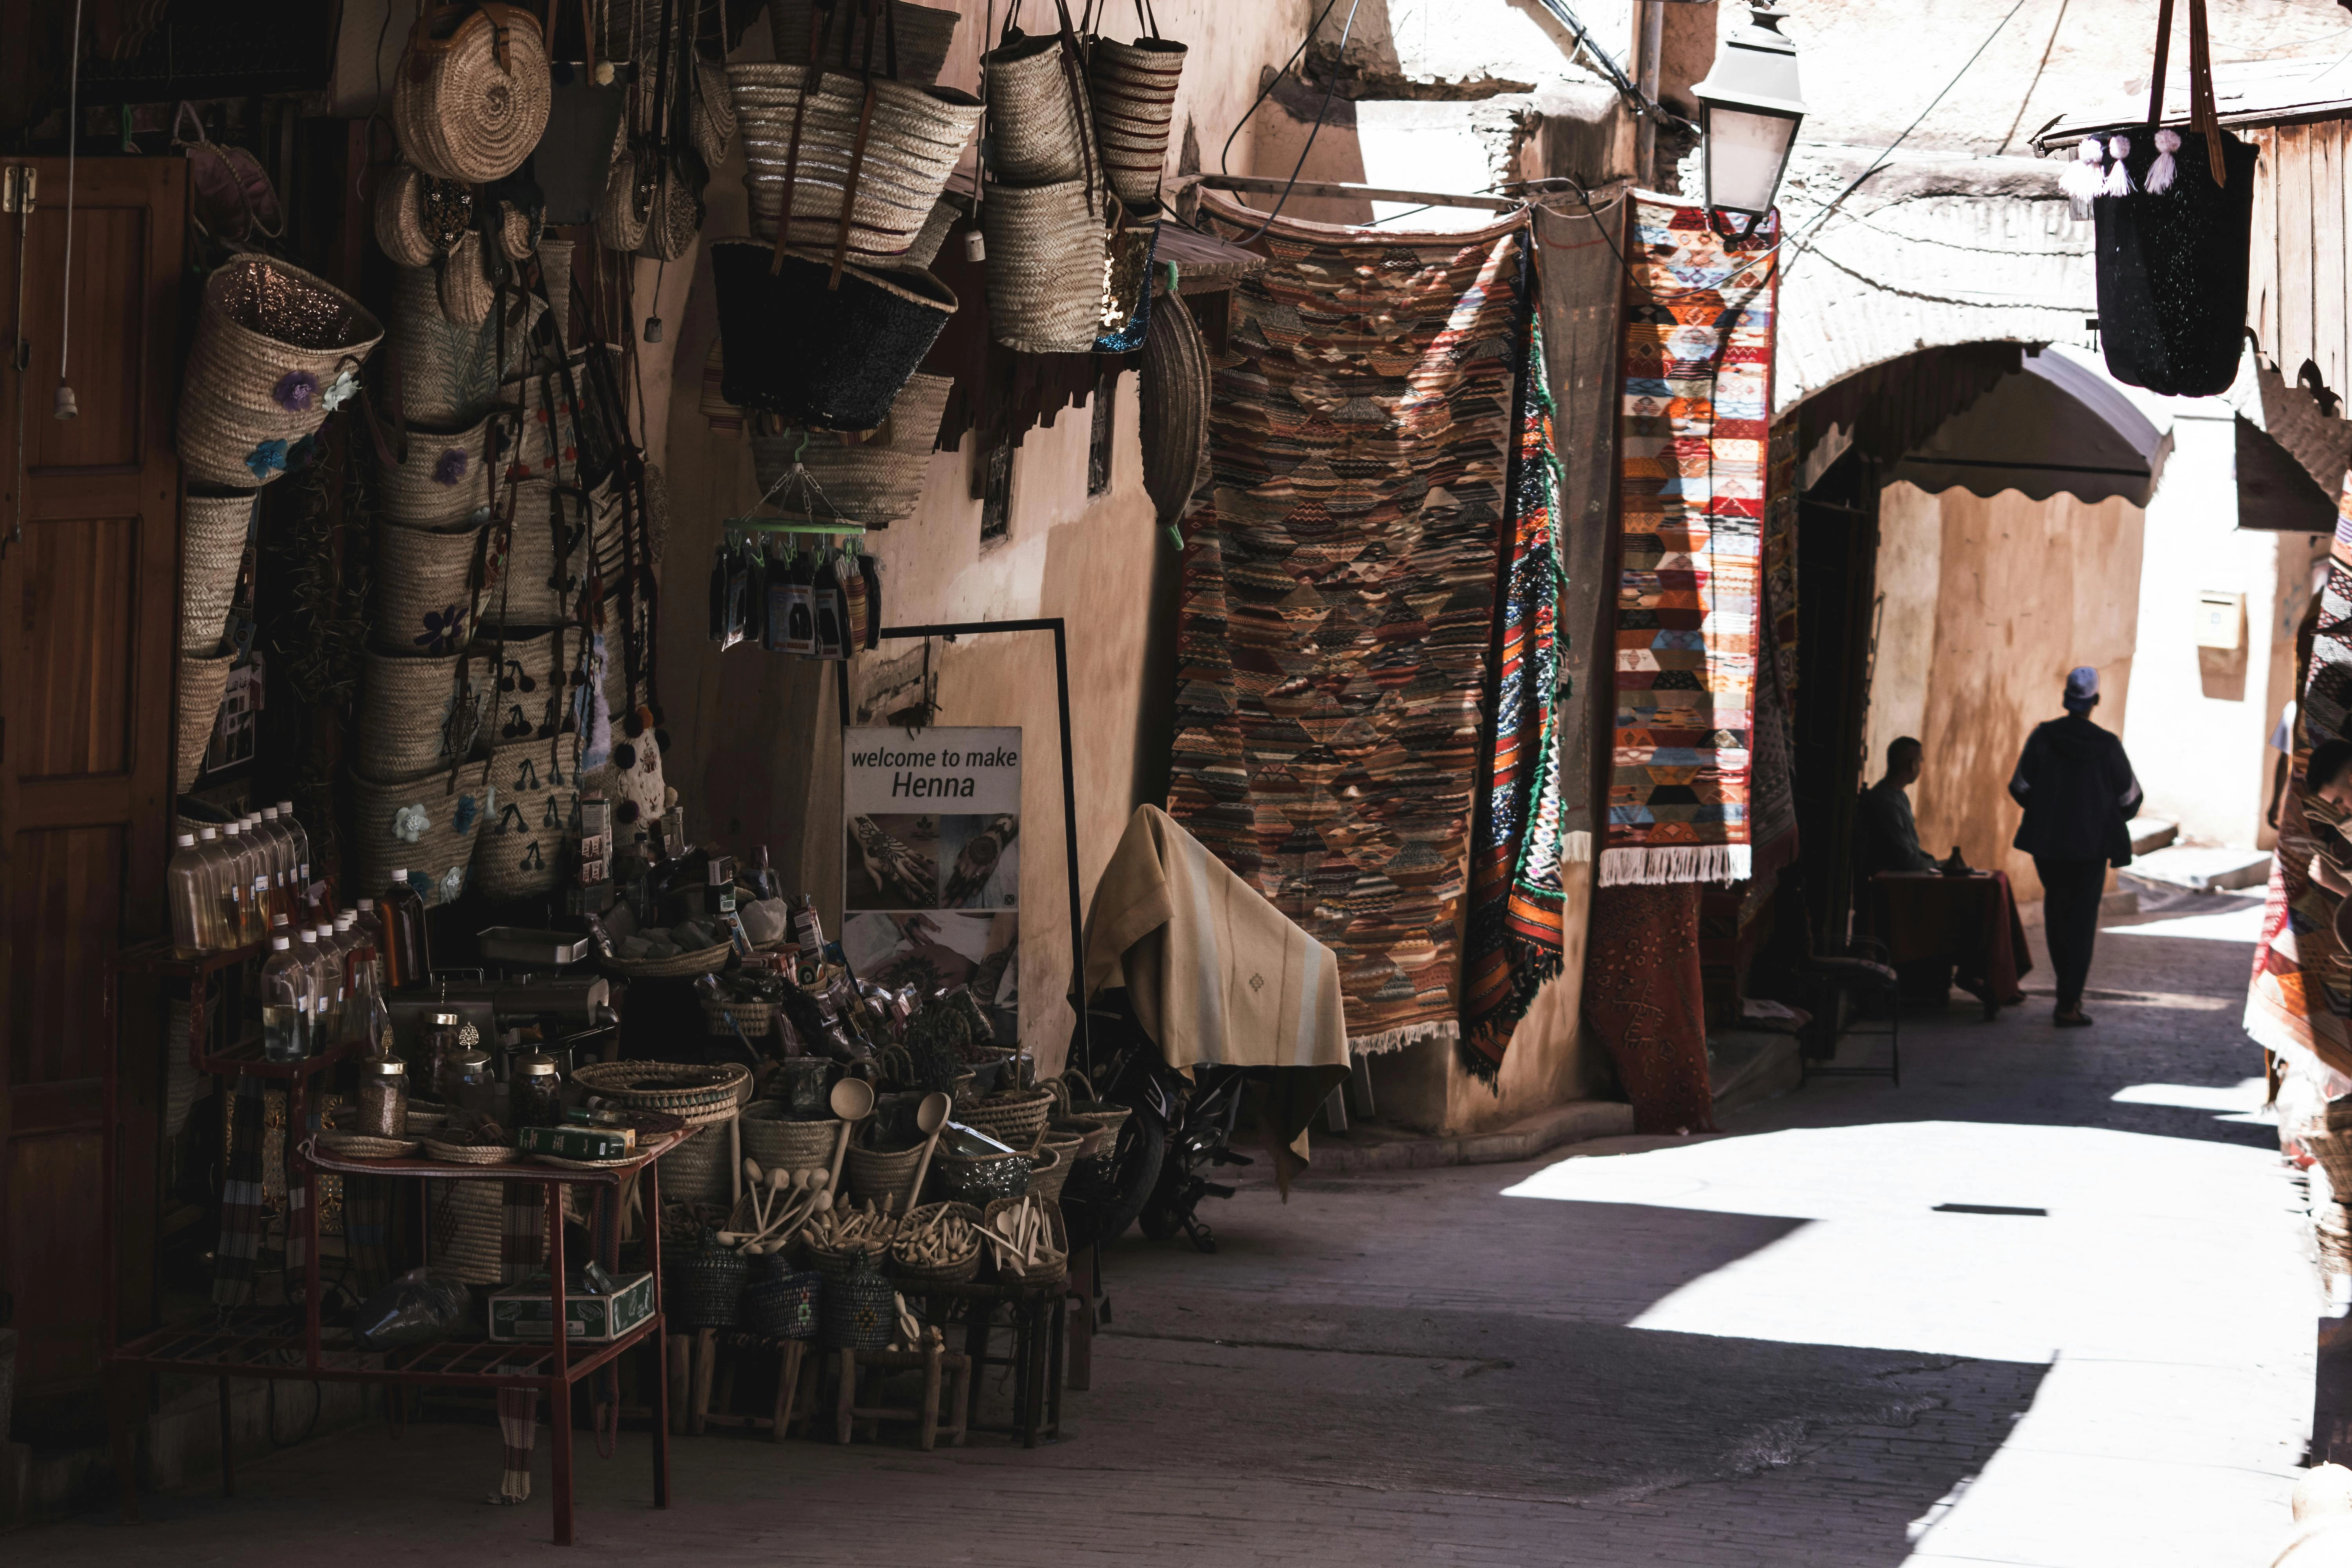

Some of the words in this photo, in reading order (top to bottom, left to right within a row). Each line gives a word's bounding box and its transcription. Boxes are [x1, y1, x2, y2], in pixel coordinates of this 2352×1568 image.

[852, 747, 935, 767] welcome
[942, 749, 960, 767] to
[965, 746, 1017, 767] make
[892, 771, 974, 797] Henna
